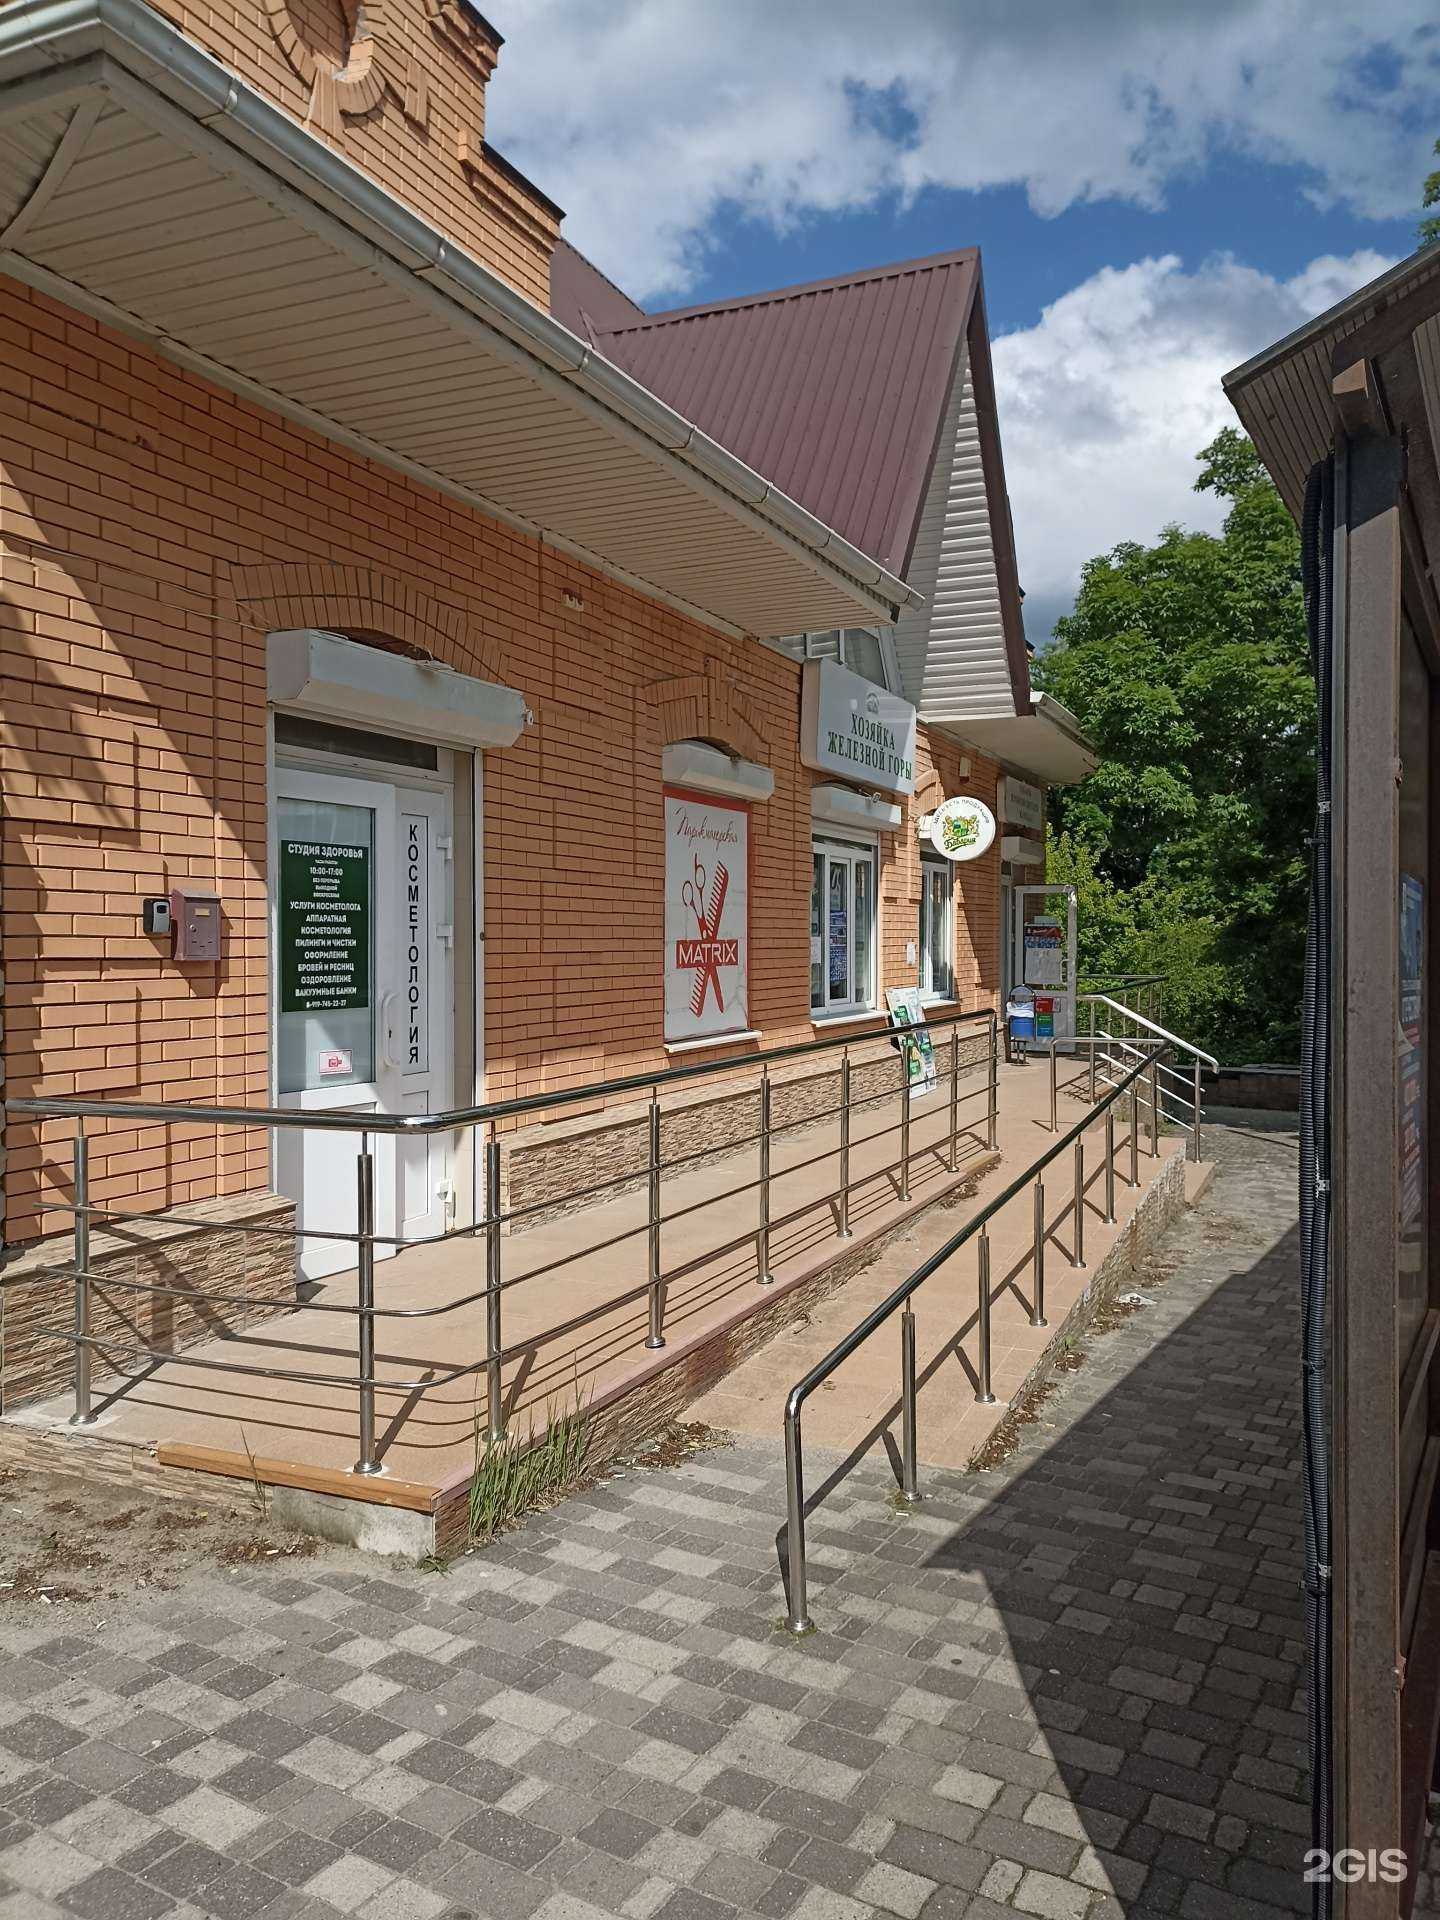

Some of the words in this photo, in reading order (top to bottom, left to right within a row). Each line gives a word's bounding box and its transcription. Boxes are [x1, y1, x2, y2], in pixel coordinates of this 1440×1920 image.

[851, 713, 895, 750] ХОЗЯЙКА
[828, 731, 885, 771] ЖЕЛЕЗНОЙ
[888, 754, 912, 780] ГОРЫ
[287, 843, 320, 857] СТУДИЯ
[321, 846, 363, 859] ЗДОРОВЬЯ
[309, 866, 344, 876] 10:00-17:00
[290, 901, 316, 910] УСЛУГИ
[316, 902, 361, 911] КОСМЕТОЛОГА
[305, 914, 347, 922] АППАРАТНАЯ
[300, 926, 352, 935] КОСМЕТОЛОГИЯ
[295, 938, 326, 947] ПИЛИНГИ
[327, 939, 332, 947] И
[332, 938, 357, 947] ЧИСТКИ
[408, 823, 419, 1065] КОСМЕТОЛОГИЯ
[304, 950, 349, 959] ОФОРМЛЕНИЕ
[679, 942, 738, 965] MATRIX
[297, 961, 323, 972] БРОВЕЙ
[324, 963, 329, 971] И
[329, 962, 355, 972] РЕСНИЦ
[300, 974, 352, 985] ОЗДОРОВЛЕНИЕ
[295, 987, 335, 997] ВАКУУМНЫЕ
[335, 986, 357, 995] БАНКИ
